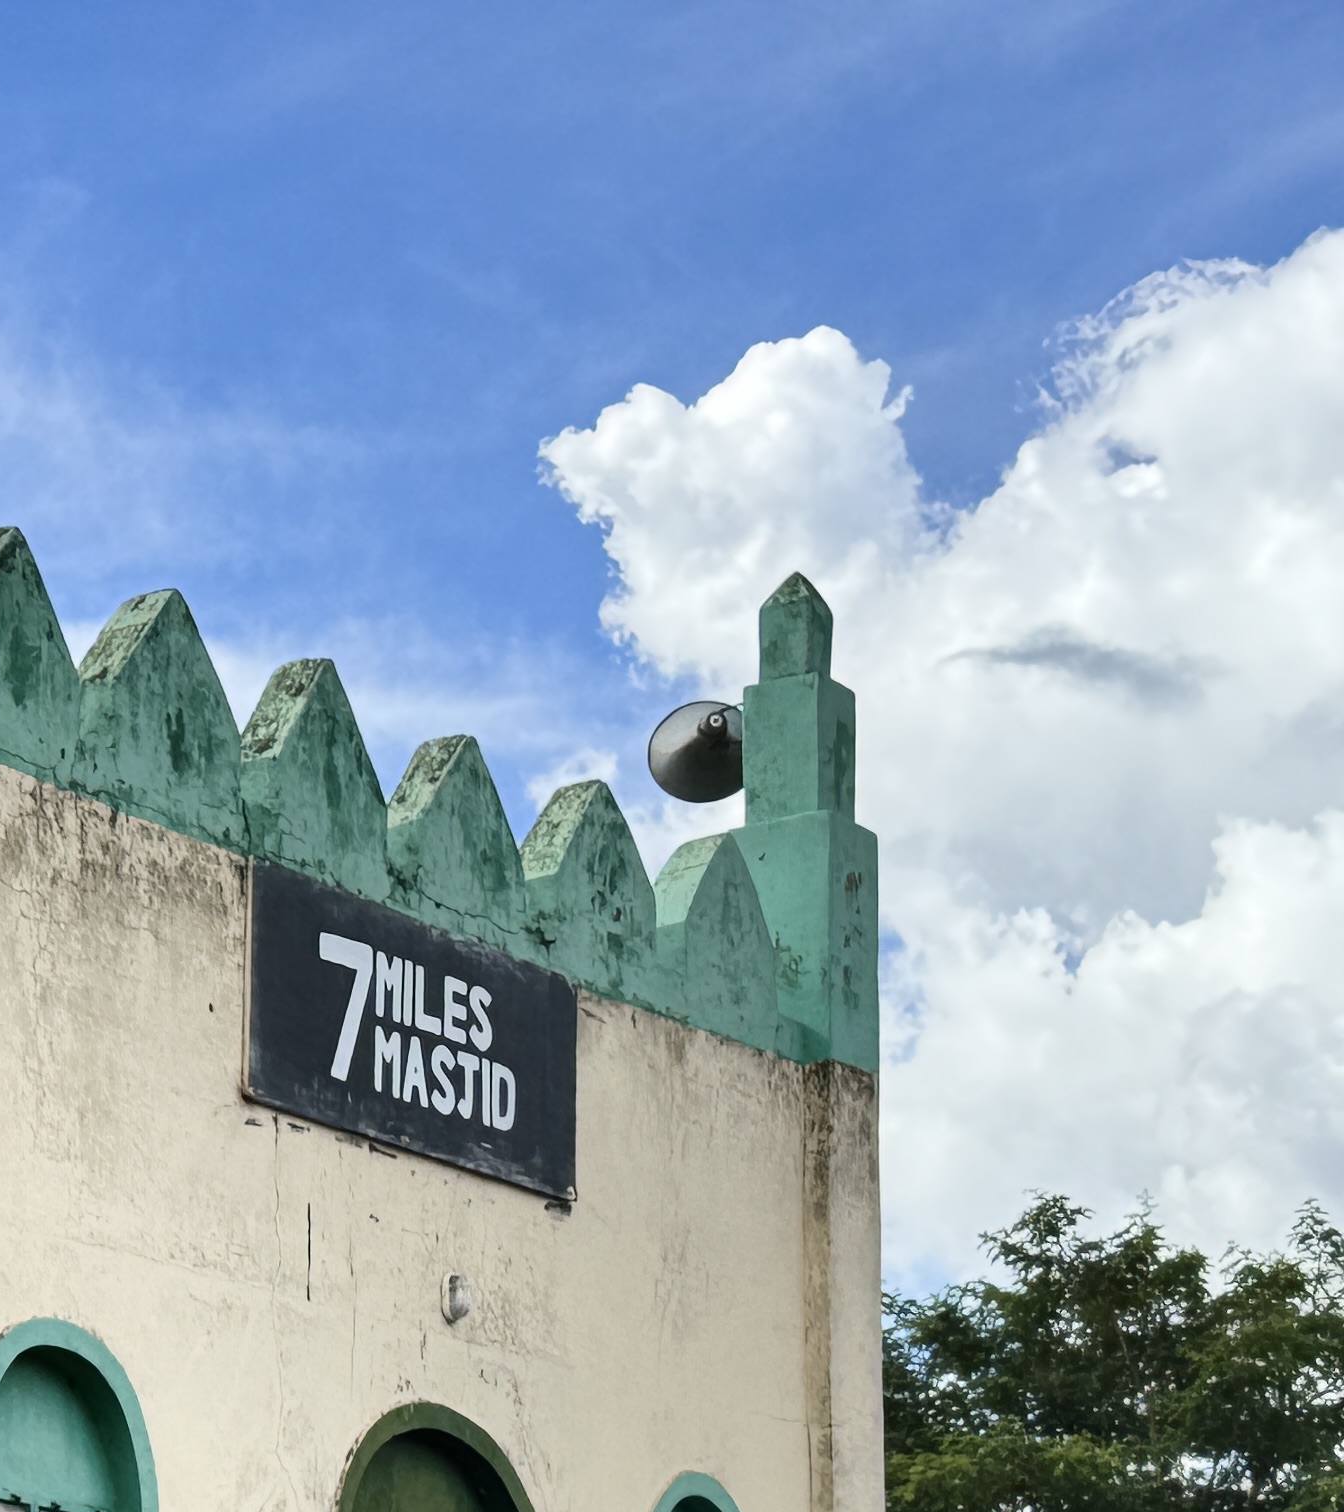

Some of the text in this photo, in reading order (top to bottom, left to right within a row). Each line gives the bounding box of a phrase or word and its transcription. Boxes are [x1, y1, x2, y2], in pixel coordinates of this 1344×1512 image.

[319, 931, 493, 1082] 7 MILES
[373, 1026, 516, 1132] MASJID
